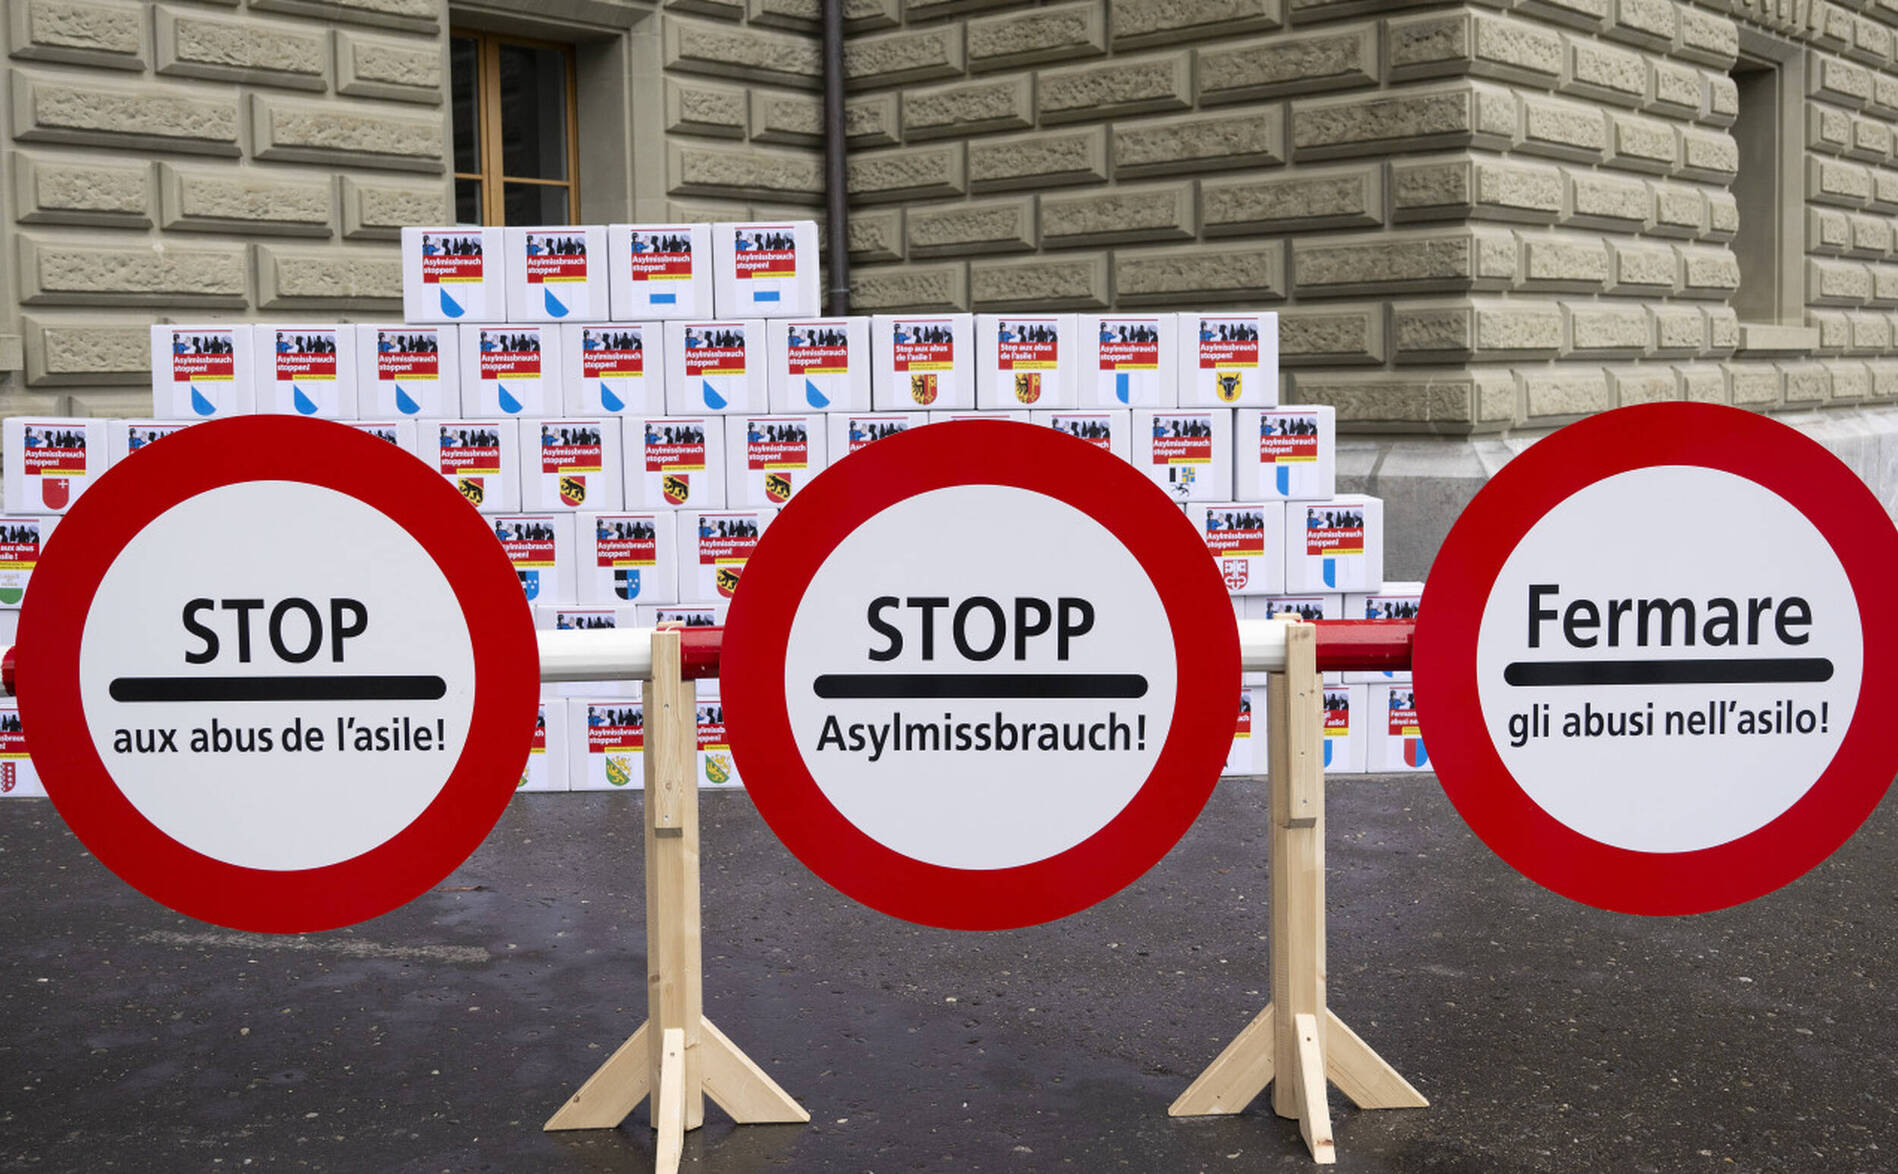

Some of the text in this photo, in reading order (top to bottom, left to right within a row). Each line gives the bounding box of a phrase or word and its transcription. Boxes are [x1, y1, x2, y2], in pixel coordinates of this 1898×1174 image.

[633, 255, 690, 264] Asylmissbrauch
[737, 253, 794, 261] Asylmissbrauch
[424, 258, 481, 266] Asylmissbrauch
[528, 258, 585, 266] Asylmissbrauch
[896, 345, 913, 353] Stop
[1000, 344, 1018, 352] Stop
[1101, 345, 1158, 353] Asylmissbrauch
[1201, 344, 1258, 352] Asylmissbrauch
[584, 353, 641, 361] Asylmissbrauch
[686, 350, 743, 358] Asylmissbrauch
[790, 349, 847, 357] Asylmissbrauch
[896, 353, 906, 361] de
[174, 356, 231, 364] Asylmissbrauch
[379, 355, 436, 363] Asylmissbrauch
[482, 354, 539, 362] Asylmissbrauch
[1154, 440, 1211, 448] Asylmissbrauch
[1261, 438, 1317, 446] Asylmissbrauch
[543, 448, 600, 456] Asylmissbrauch
[647, 446, 704, 454] Asylmissbrauch
[749, 445, 806, 453] Asylmissbrauch
[26, 450, 83, 458] Asylmissbrauch
[442, 449, 498, 458] Asylmissbrauch
[1308, 531, 1363, 539] Asylmissbrauch
[502, 542, 553, 551] sylmissbrauch
[1529, 584, 1812, 648] Fermare
[183, 598, 367, 664] STOP
[868, 596, 1094, 661] STOPP
[1509, 700, 1828, 747] gli abusi nell'asilo!
[114, 717, 444, 753] aux abus de l'asile!
[817, 712, 1145, 762] Asylmissbrauch!
[589, 736, 621, 746] stoppen!
